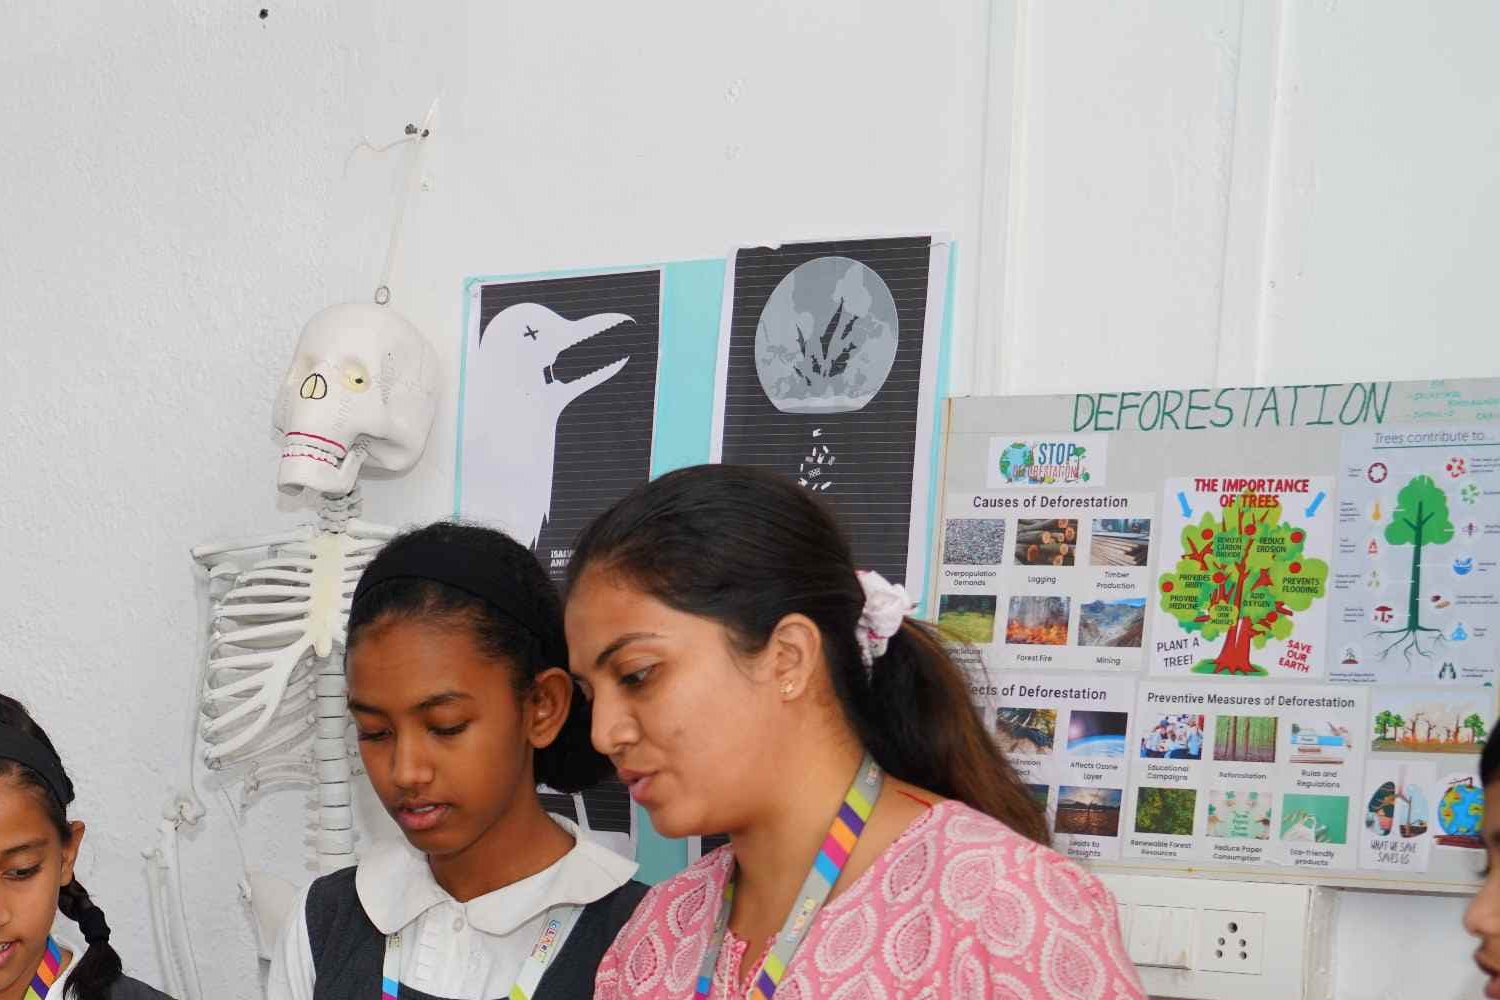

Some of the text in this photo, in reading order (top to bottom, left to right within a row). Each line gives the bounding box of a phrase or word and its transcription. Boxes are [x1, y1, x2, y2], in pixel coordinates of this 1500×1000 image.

[1072, 381, 1392, 432] DEFORESTATION
[1373, 433, 1404, 444] Trees
[1407, 431, 1470, 443] contribute
[1038, 442, 1077, 465] STOP
[1194, 478, 1310, 493] THE IMPORTANCE
[973, 495, 1129, 509] Causes of Deforestation
[1219, 494, 1279, 508] OF TREES
[1259, 537, 1285, 545] REDUCE
[945, 570, 997, 579] Overpopulation
[1104, 571, 1130, 579] Timber
[1028, 576, 1056, 584] Logging
[1282, 577, 1320, 586] PREVENTS
[1096, 582, 1135, 590] Production
[1282, 586, 1318, 594] FLOODING
[1157, 637, 1200, 652] PLANT A
[1286, 639, 1312, 653] SAVE
[1016, 654, 1038, 662] Forest
[1287, 650, 1307, 662] OUR
[1096, 656, 1121, 666] Mining
[1279, 657, 1310, 673] EARTH
[1002, 685, 1016, 697] of
[1019, 685, 1107, 700] Deforestation
[1147, 692, 1355, 708] Preventive Measures of Deforestation
[1070, 762, 1094, 770] Affects
[1147, 764, 1189, 772] Educational
[1083, 773, 1102, 781] Layer
[1147, 773, 1188, 781] Campaigns
[1323, 770, 1338, 778] and
[1296, 779, 1340, 789] Regulations
[1130, 839, 1192, 848] Renewable Forest
[1214, 844, 1240, 853] Reduce
[1212, 853, 1261, 862] Consumption
[1295, 857, 1329, 866] products
